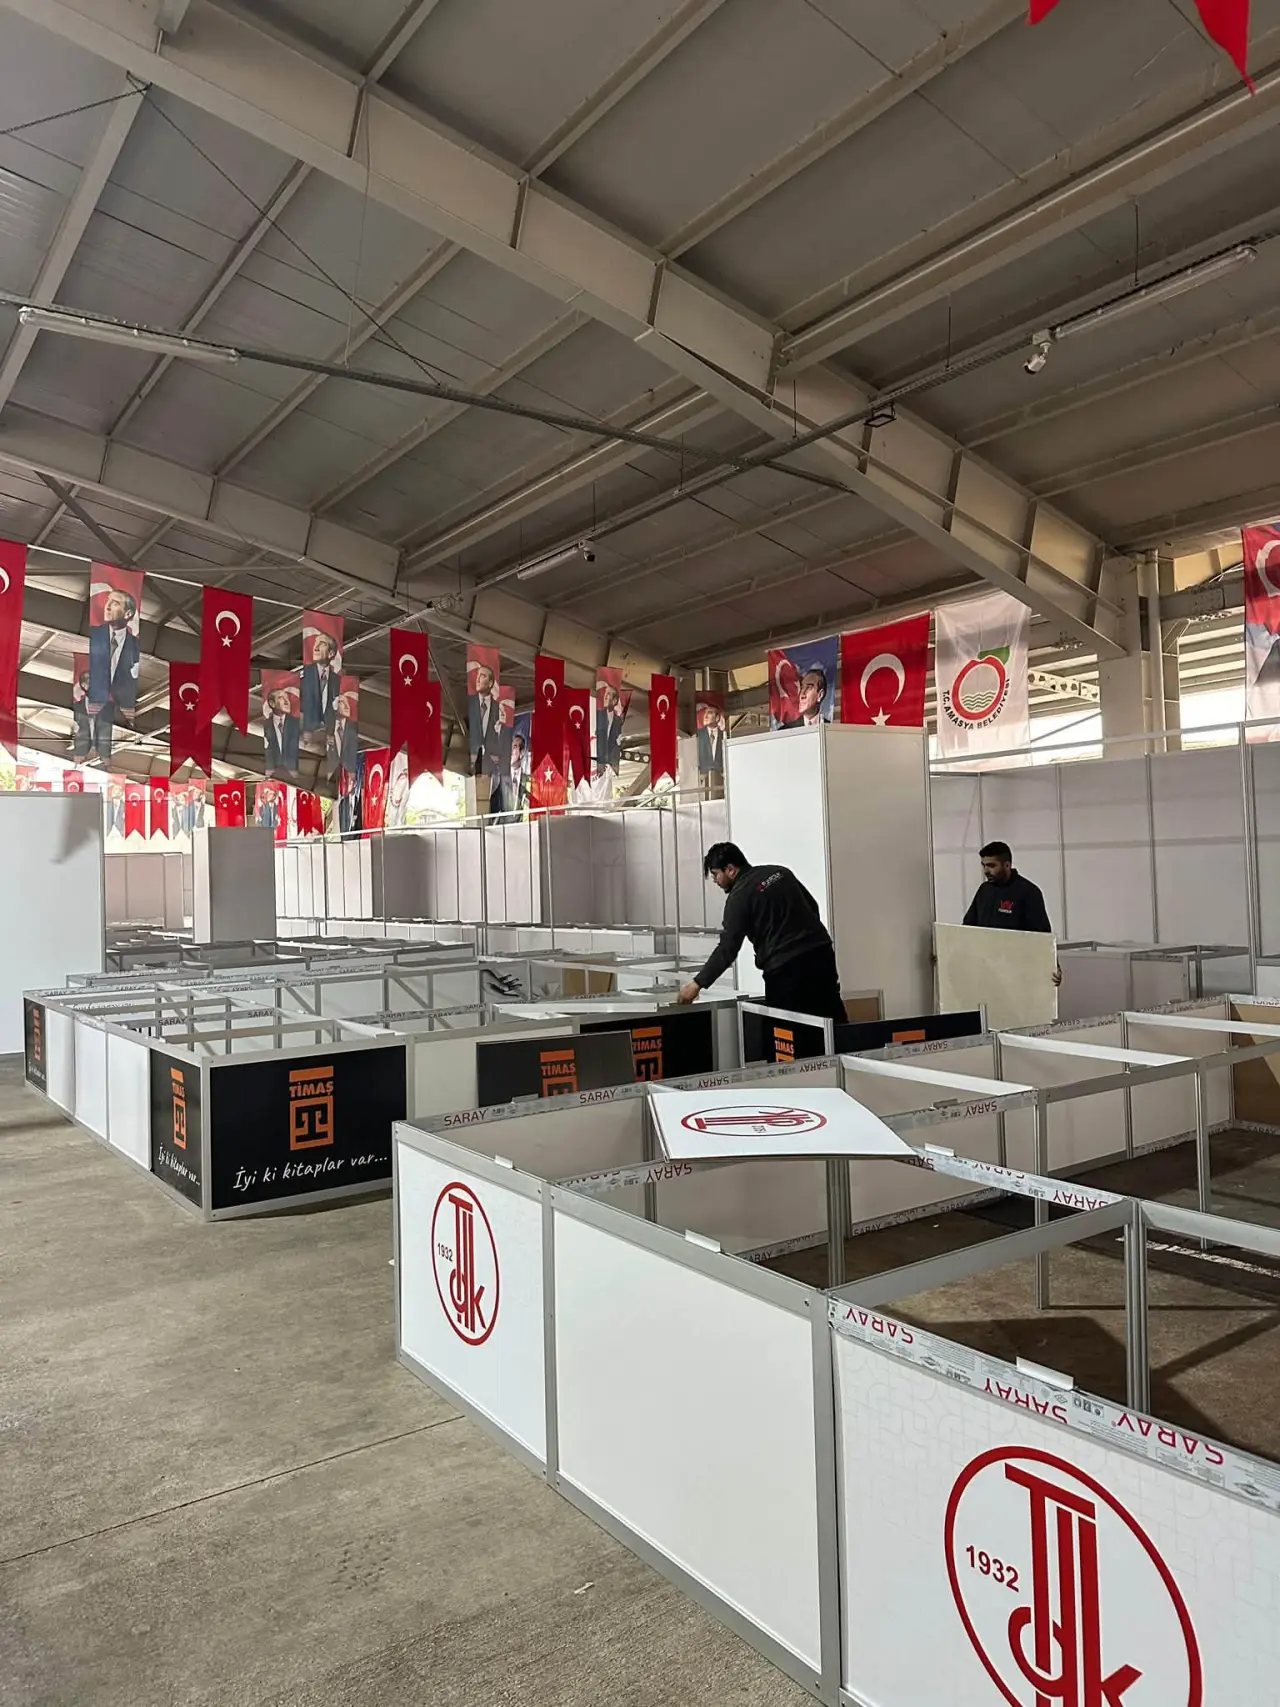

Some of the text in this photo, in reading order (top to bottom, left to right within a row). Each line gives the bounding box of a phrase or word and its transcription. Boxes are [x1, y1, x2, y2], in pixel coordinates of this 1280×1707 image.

[944, 706, 974, 730] AMASYA
[158, 1018, 186, 1026] SARAY
[247, 1010, 273, 1018] SARAY
[923, 1041, 948, 1052] SARAY
[800, 1059, 828, 1073] SARAY
[289, 1081, 334, 1098] TİMAŞ
[698, 1076, 729, 1089] SARAY
[579, 1087, 618, 1105] SARAY
[965, 1101, 998, 1116] SARAY
[444, 1109, 488, 1127] SARAY
[232, 1153, 388, 1191] İyi ki kitaplar var...
[646, 1163, 692, 1183] SARAY
[853, 1224, 881, 1237] SARAY
[437, 1242, 453, 1262] 1932
[845, 1308, 913, 1345] SARAY
[983, 1378, 1068, 1425] SARAY
[1117, 1413, 1224, 1465] SARAY
[965, 1543, 1020, 1593] 1932
